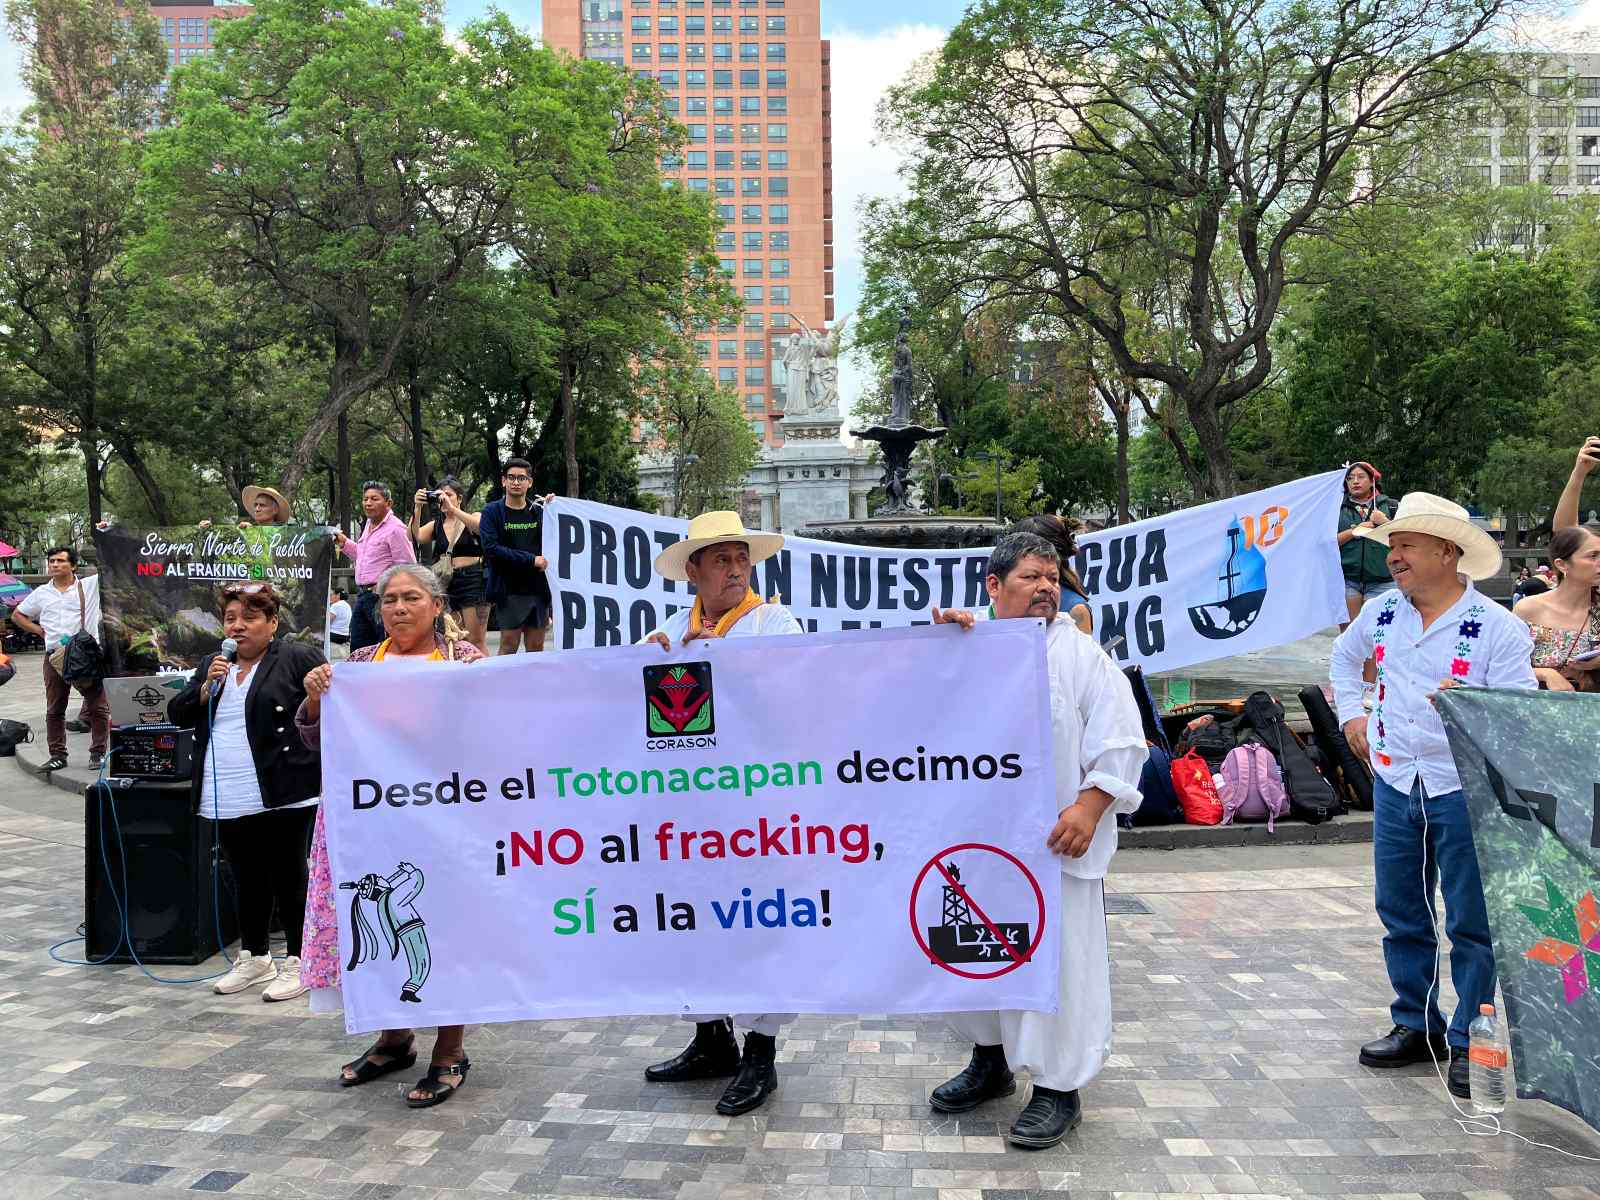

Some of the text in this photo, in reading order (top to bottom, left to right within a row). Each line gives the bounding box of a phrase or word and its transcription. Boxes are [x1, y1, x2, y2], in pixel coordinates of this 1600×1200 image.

[140, 530, 307, 558] Sierra Norte de Puebla
[558, 513, 1169, 610] PROTN NUESTR GUA
[137, 562, 163, 577] NO
[166, 563, 184, 576] AL
[187, 563, 250, 578] FRAKING,
[266, 567, 273, 577] a
[274, 564, 287, 577] la
[287, 563, 313, 579] vida
[646, 737, 717, 750] CORASON
[352, 745, 1023, 810] Desde el Totonacapan decimos
[495, 813, 885, 876] ¡NO al fracking,
[553, 887, 832, 936] SÍ a la vida!
